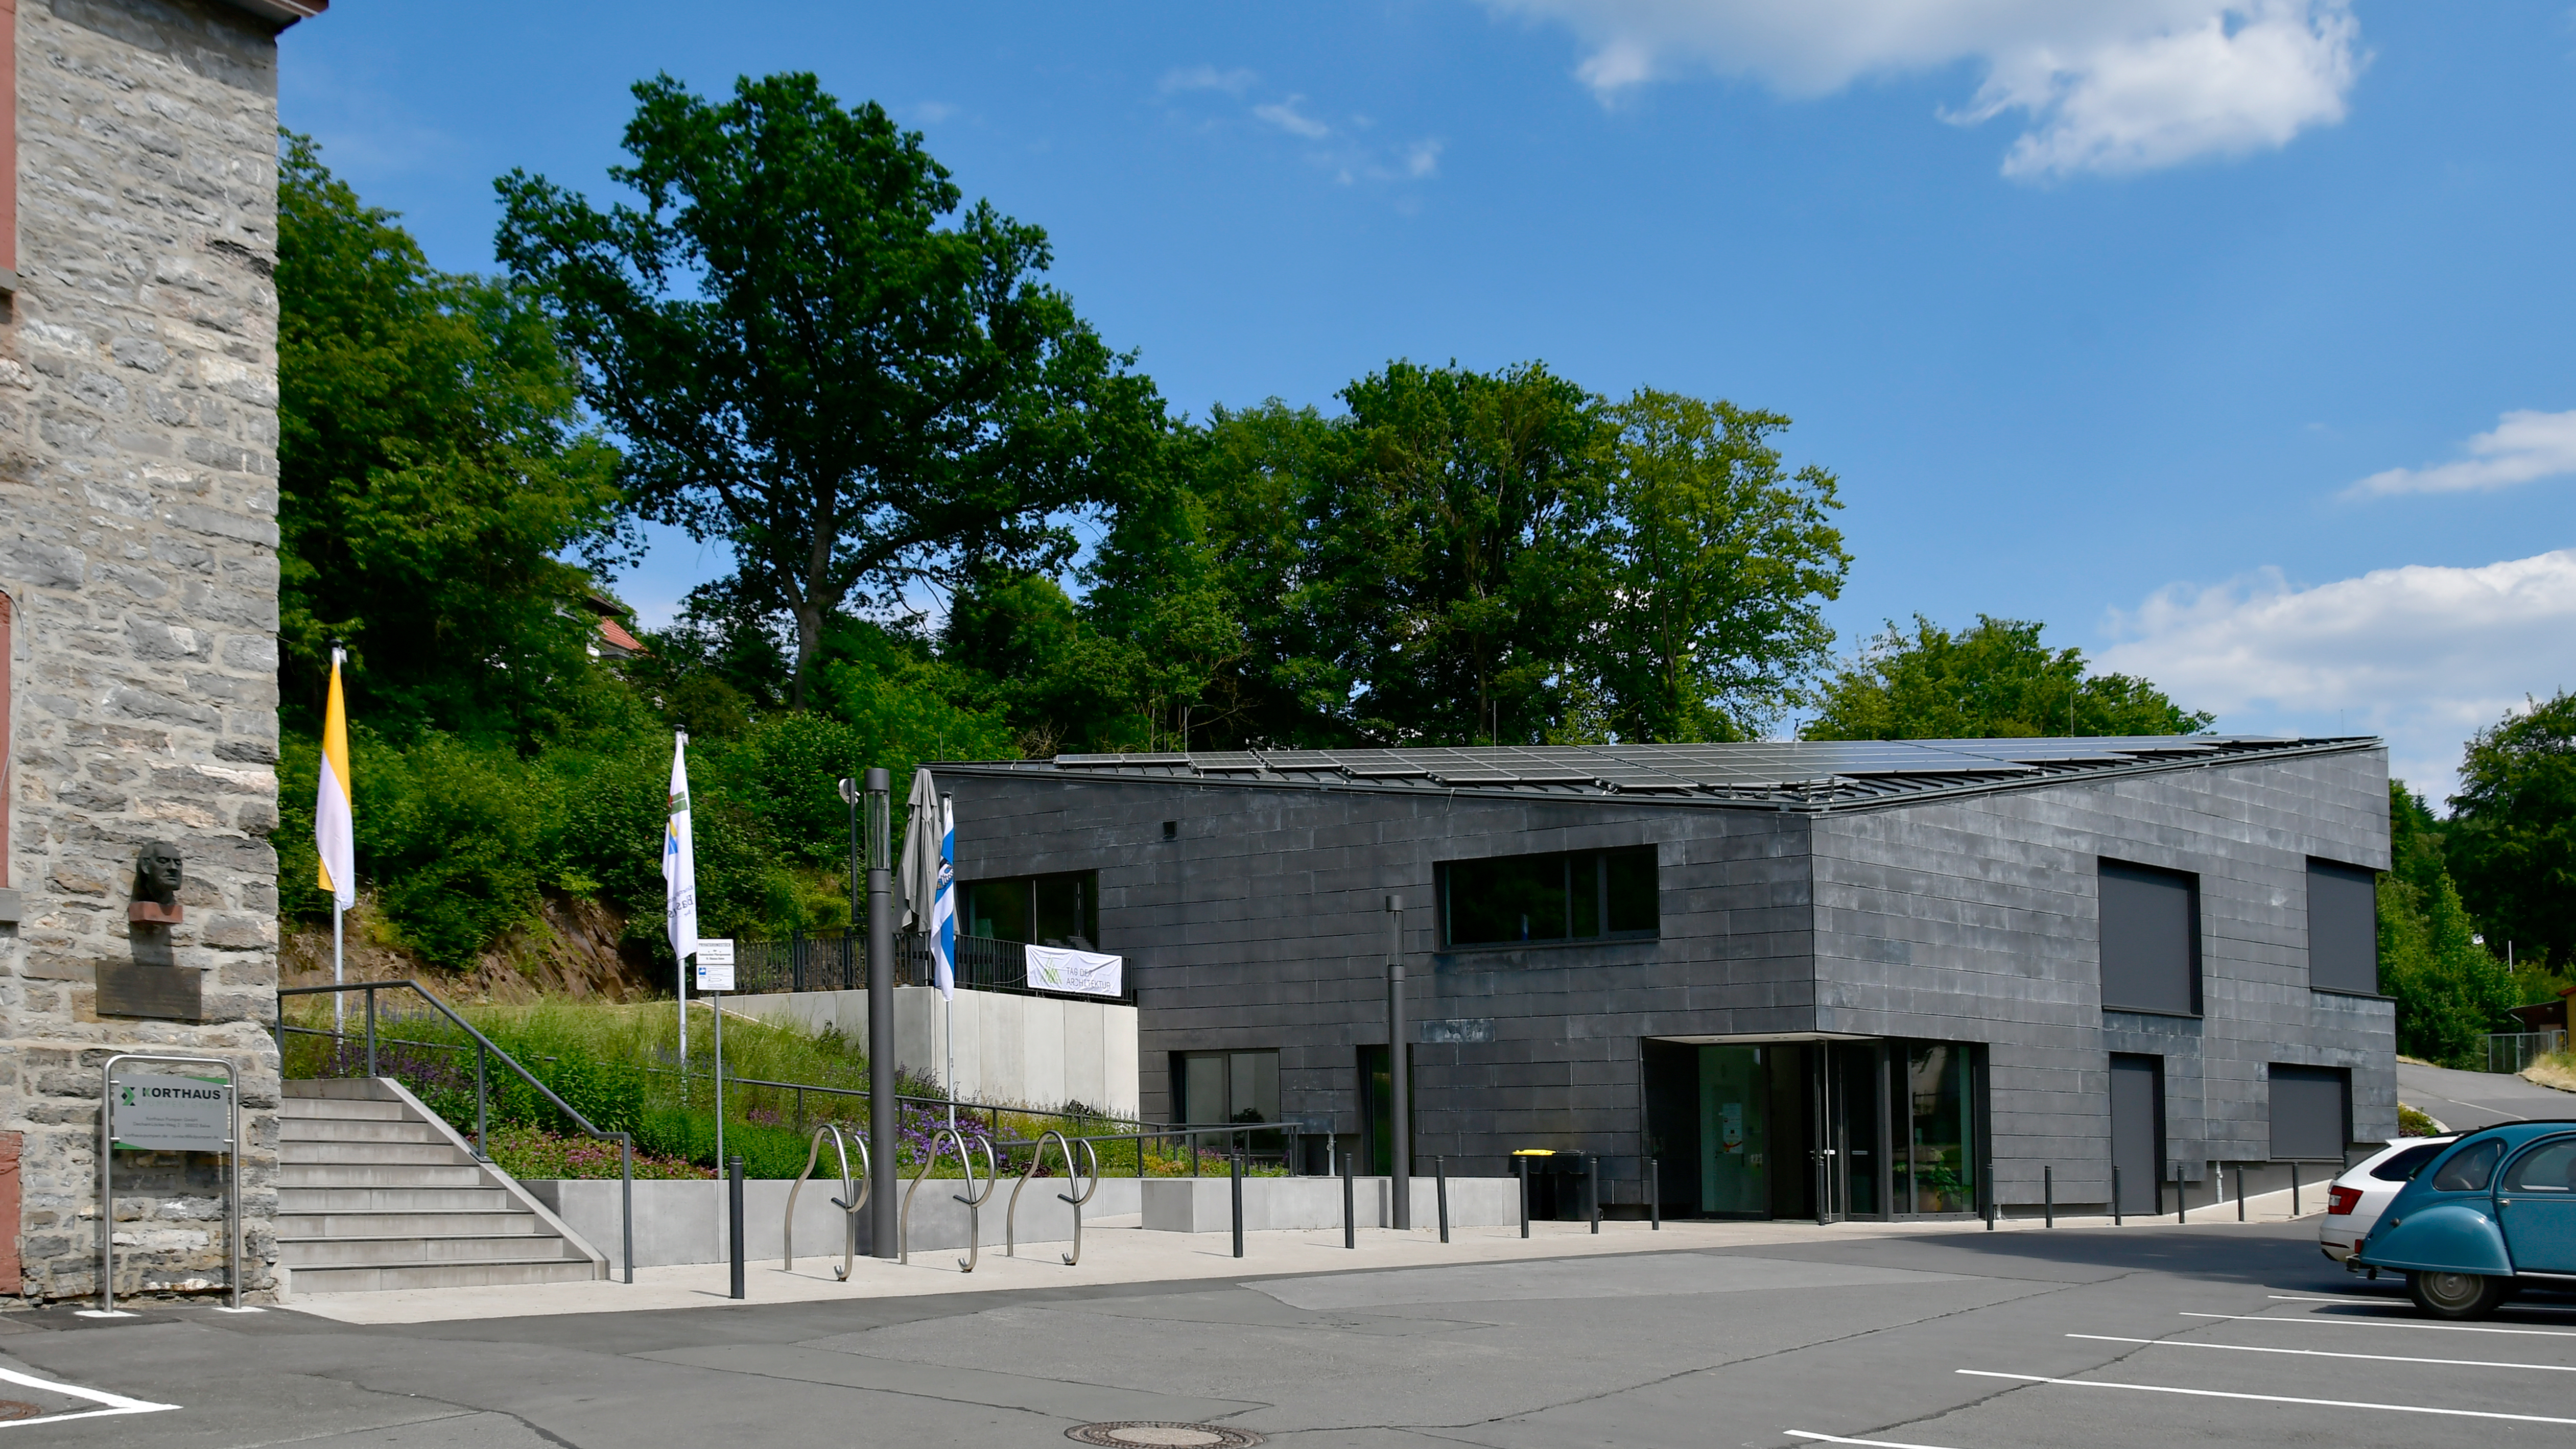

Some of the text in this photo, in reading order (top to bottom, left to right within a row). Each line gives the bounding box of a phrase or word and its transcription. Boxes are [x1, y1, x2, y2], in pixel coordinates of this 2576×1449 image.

[1066, 967, 1092, 978] TAG DER
[1066, 978, 1111, 989] ARCHITEKTUR
[143, 1087, 221, 1100] KORTHAUS
